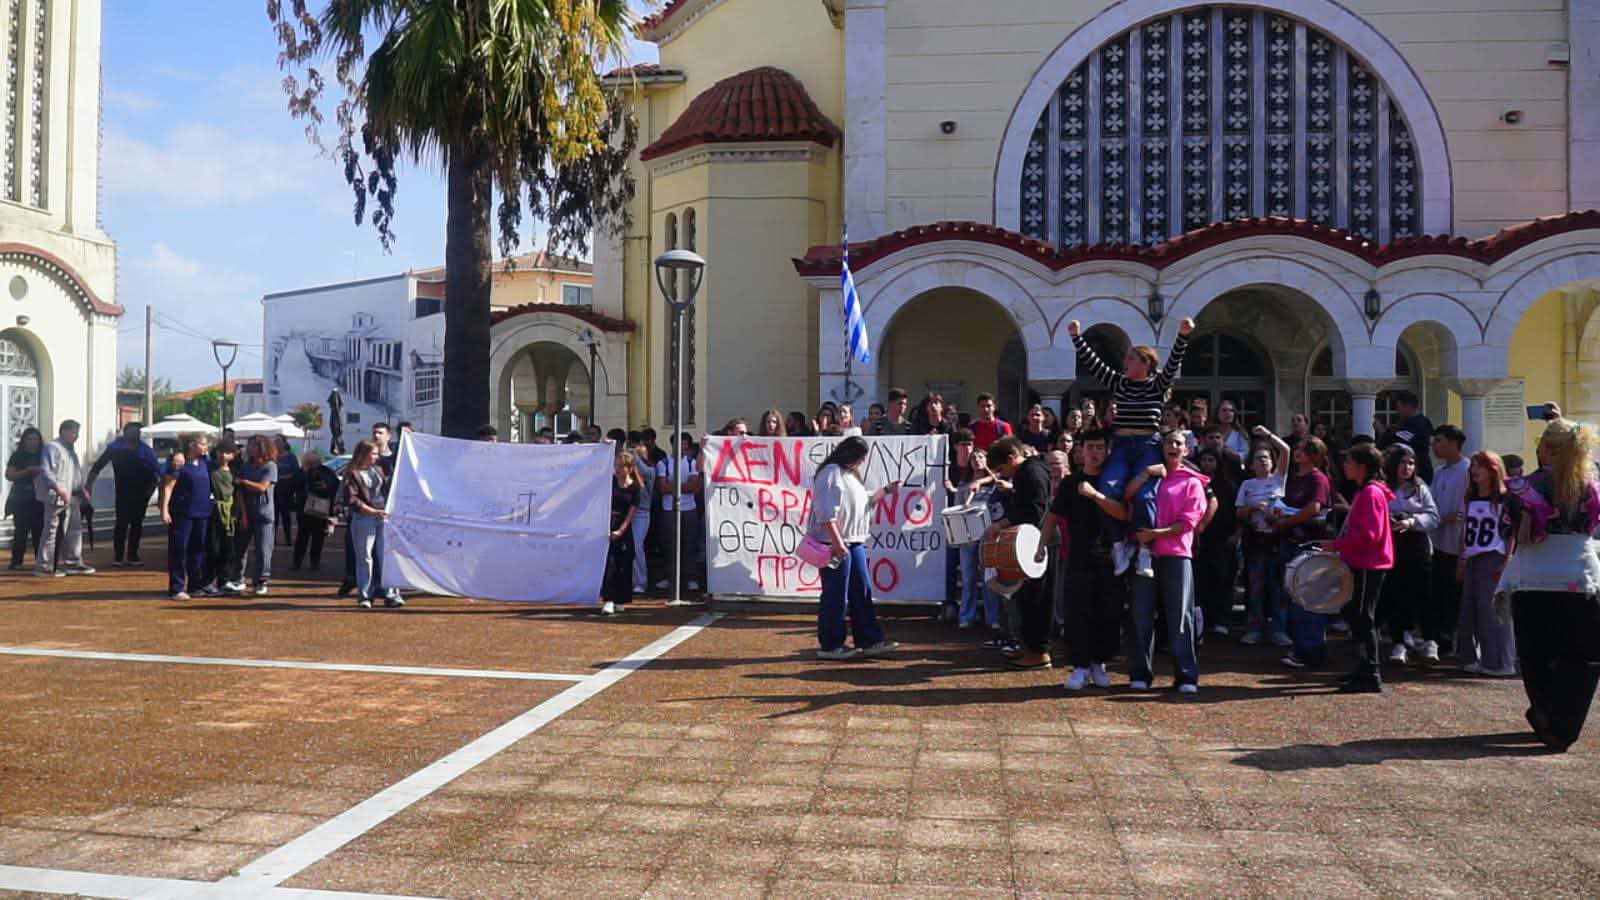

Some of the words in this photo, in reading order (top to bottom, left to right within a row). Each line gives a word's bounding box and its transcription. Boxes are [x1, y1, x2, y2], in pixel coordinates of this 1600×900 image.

[712, 439, 805, 486] ΔΕΝ
[864, 440, 951, 488] ΛΥΣΗ
[716, 487, 740, 506] ΤΟ
[871, 530, 941, 552] ΧΟΛΕΙΟ
[1465, 517, 1495, 547] 66
